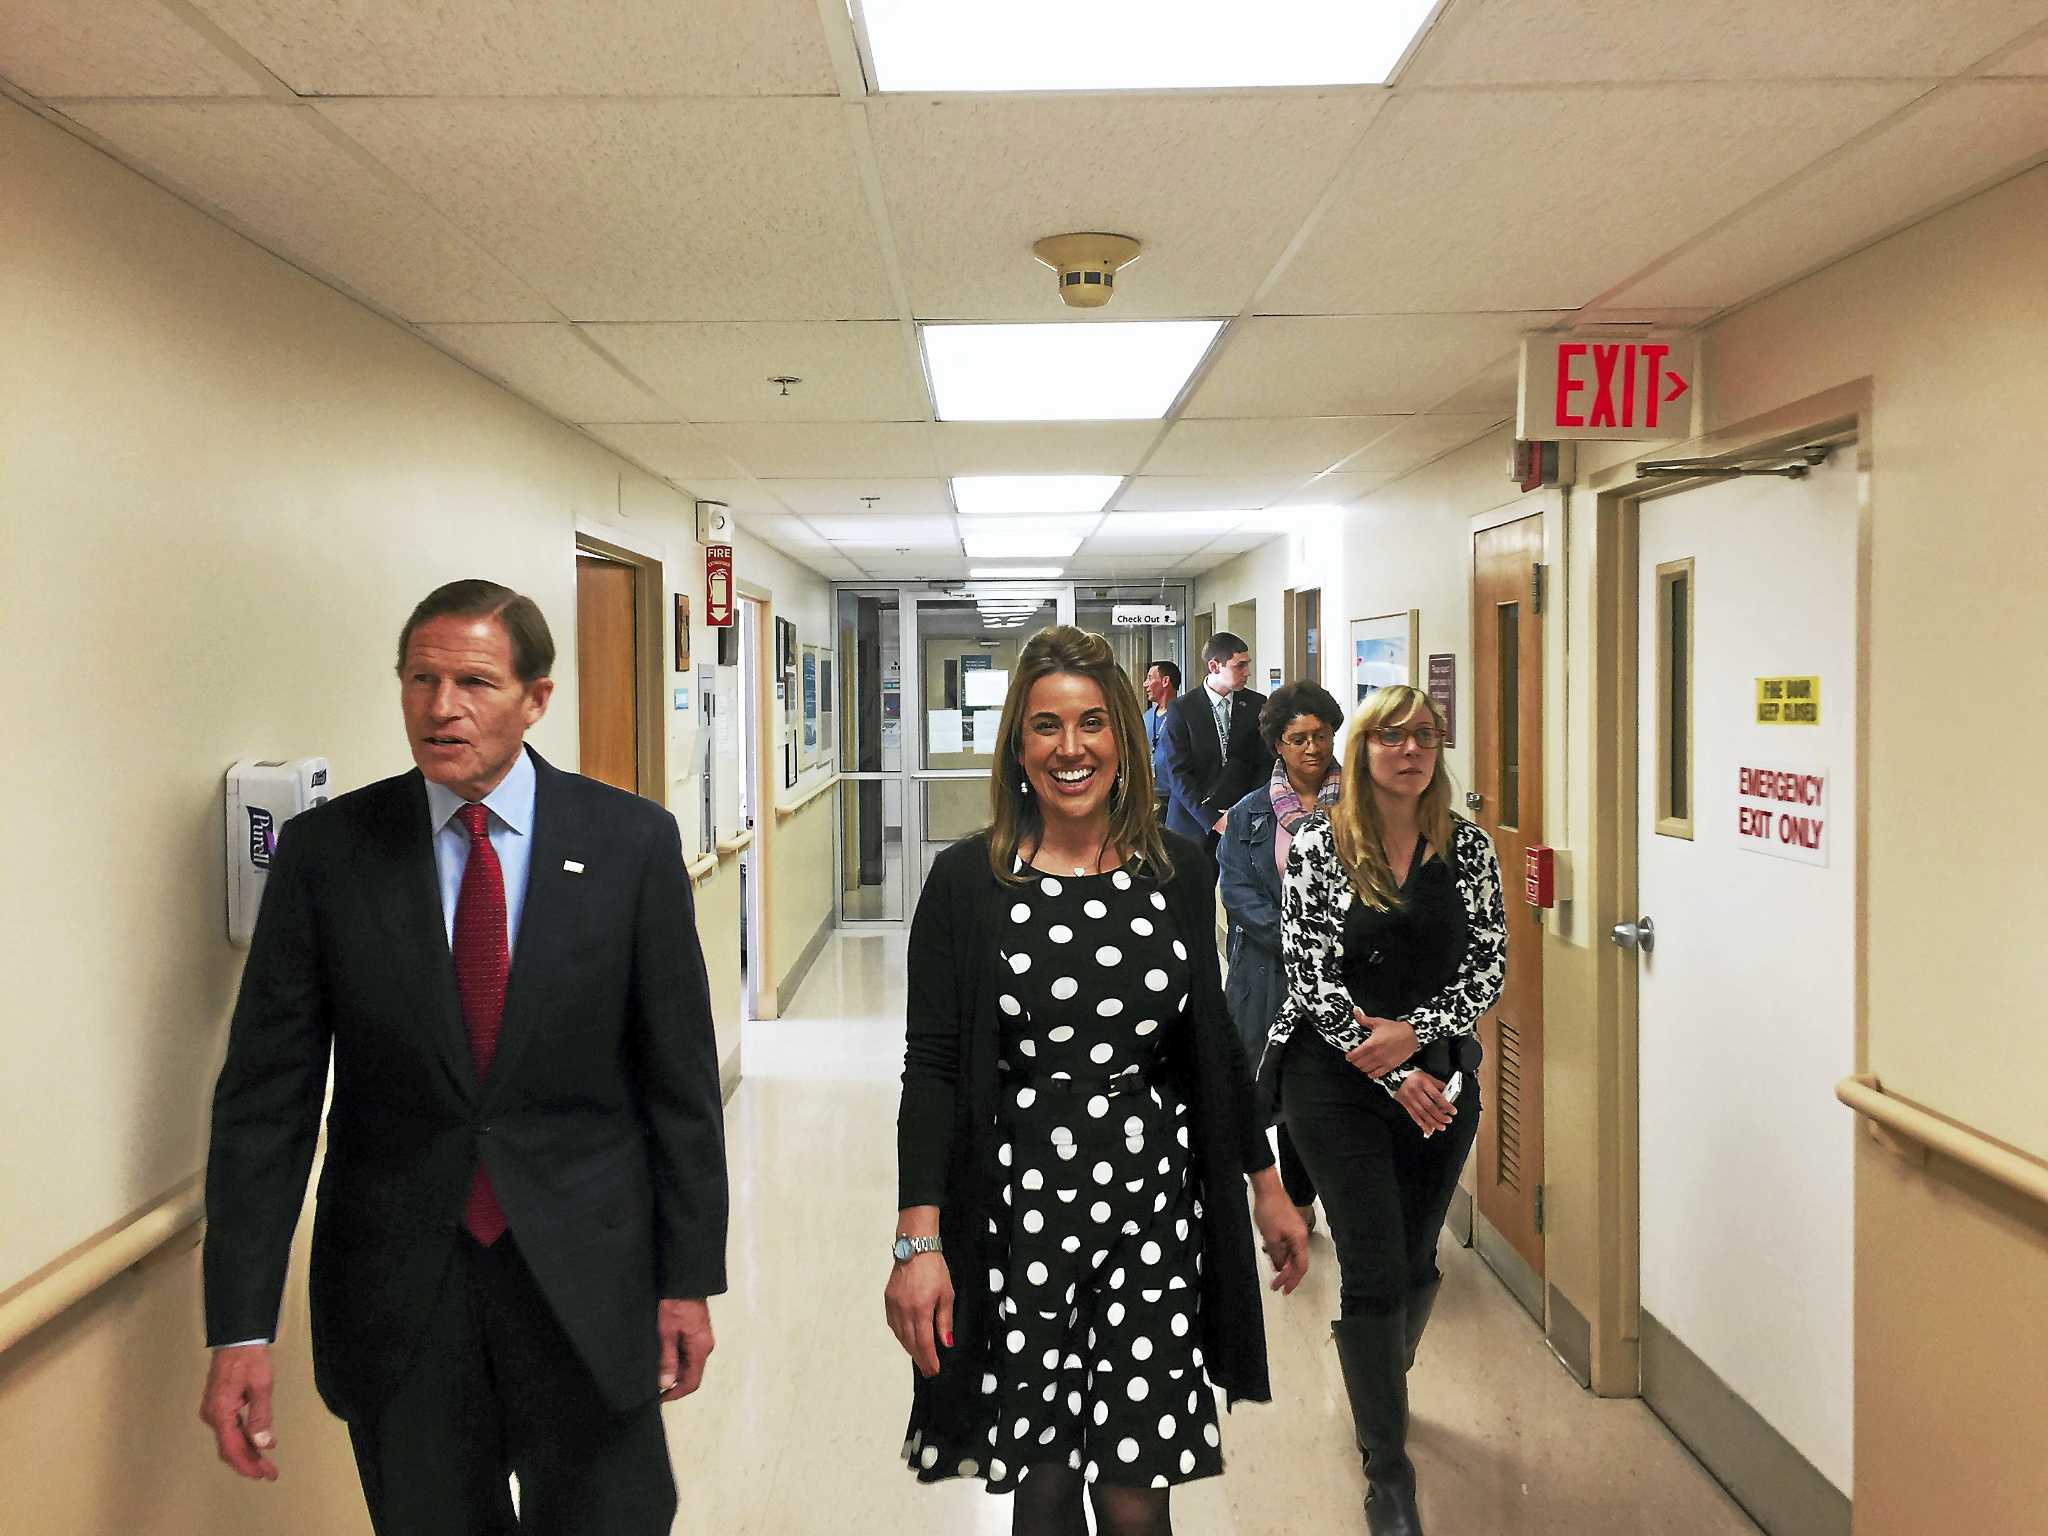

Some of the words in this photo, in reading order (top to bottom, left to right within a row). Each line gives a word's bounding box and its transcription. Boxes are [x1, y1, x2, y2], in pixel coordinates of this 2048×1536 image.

[1556, 343, 1670, 428] EXIT
[707, 548, 731, 558] FIRE
[1117, 615, 1142, 623] Check
[1144, 615, 1160, 623] Out
[1739, 767, 1824, 806] EMERGENCY
[253, 814, 270, 864] Purell
[1739, 806, 1773, 839] EXIT
[1779, 813, 1824, 850] ONLY
